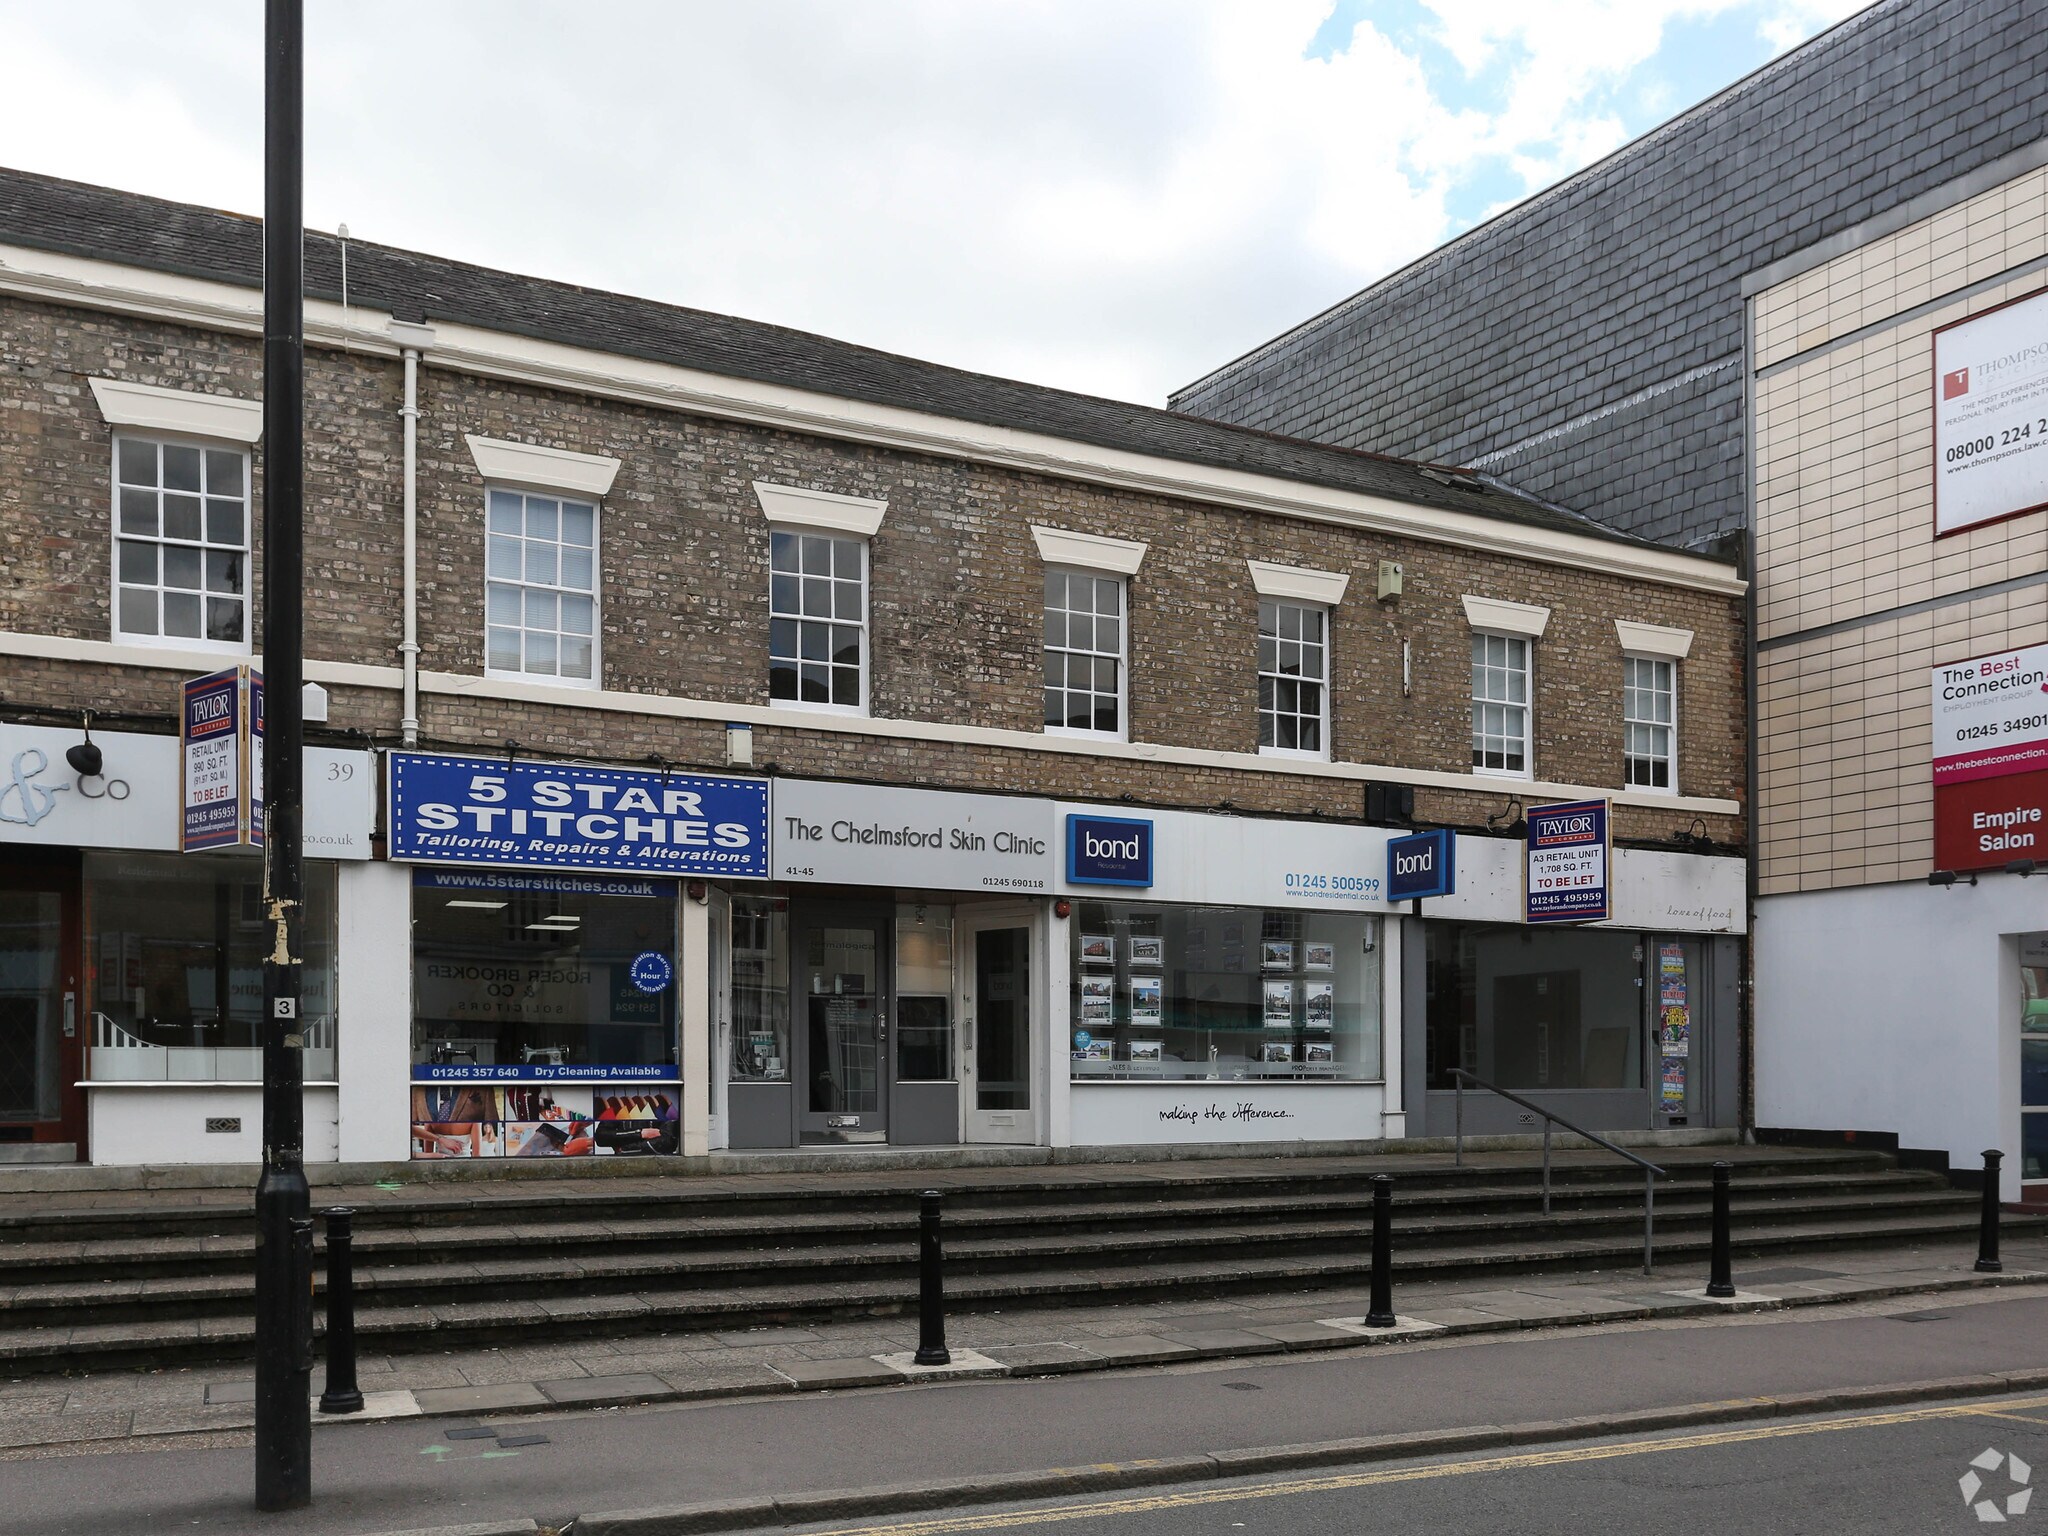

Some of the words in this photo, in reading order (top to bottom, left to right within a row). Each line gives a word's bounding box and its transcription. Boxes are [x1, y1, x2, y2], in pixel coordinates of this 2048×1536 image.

[1962, 403, 1976, 412] THE
[1978, 394, 1998, 407] MOST
[2000, 377, 2048, 399] EXPERIENCE
[1944, 410, 1982, 426] PERSONAL
[1984, 401, 2009, 415] INJURY
[2011, 393, 2029, 405] FIRM
[2030, 389, 2041, 399] IN
[1946, 435, 1995, 463] 08000
[2001, 422, 2031, 447] 224
[2037, 417, 2048, 435] 2
[1946, 437, 2048, 475] www.thompsons.law.c
[1943, 666, 1975, 684] The
[1980, 656, 2021, 678] Best
[1942, 669, 2045, 701] Connection
[193, 694, 229, 722] TAYLOR
[1943, 696, 2000, 713] EMPLOYMENT
[2001, 689, 2034, 702] GROUP
[1956, 722, 1998, 741] 01245
[2002, 713, 2048, 733] 34901
[192, 745, 213, 759] RETAIL
[214, 740, 230, 754] UNIT
[193, 761, 204, 773] 990
[327, 762, 354, 782] 39
[193, 791, 203, 803] TO
[204, 788, 214, 800] BE
[215, 785, 229, 798] LET
[468, 775, 507, 802] 5
[532, 780, 705, 817] STAR
[187, 811, 207, 825] 01245
[208, 805, 236, 821] 495959
[1973, 806, 2042, 831] Empire
[415, 803, 751, 848] STITCHES
[1539, 817, 1593, 835] TAYLOR
[785, 817, 823, 841] The
[831, 820, 943, 849] Chelmsford
[950, 828, 985, 851] Skin
[993, 831, 1046, 855] Clinic
[1085, 831, 1139, 860] bond
[1979, 832, 2035, 852] Salon
[415, 832, 521, 853] Tailoring,
[528, 839, 610, 857] Repairs
[616, 844, 632, 857] &
[637, 845, 752, 864] Alterations
[1533, 854, 1545, 863] A3
[1546, 851, 1577, 862] RETAIL
[1578, 849, 1600, 859] UNIT
[1396, 846, 1432, 876] bond
[1539, 863, 1562, 875] 1,708
[1563, 862, 1579, 872] SQ.
[1580, 861, 1593, 871] FT.
[785, 866, 815, 877] 41-45
[1538, 879, 1553, 888] TO
[1555, 877, 1571, 887] BE
[1574, 875, 1595, 886] LET
[435, 873, 653, 896] www.5starstitches.co.uk
[982, 877, 1010, 888] 01245
[1011, 878, 1044, 889] 690118
[1285, 873, 1327, 889] 01245
[1331, 876, 1380, 892] 500599
[1285, 889, 1380, 901] www.bondresidential.co.uk
[1531, 895, 1560, 905] 01245
[1563, 892, 1602, 903] 495959
[1531, 901, 1602, 913] www.taylorandcompany.co.uk
[640, 972, 661, 980] Hour
[634, 980, 667, 993] Available
[278, 1001, 291, 1015] 3
[432, 1068, 469, 1077] 01245
[472, 1068, 494, 1077] 357
[497, 1068, 519, 1077] 640
[535, 1067, 555, 1079] Dry
[558, 1067, 608, 1079] Cleaning
[610, 1067, 661, 1076] Available
[1158, 1104, 1199, 1124] making
[1204, 1103, 1227, 1121] the
